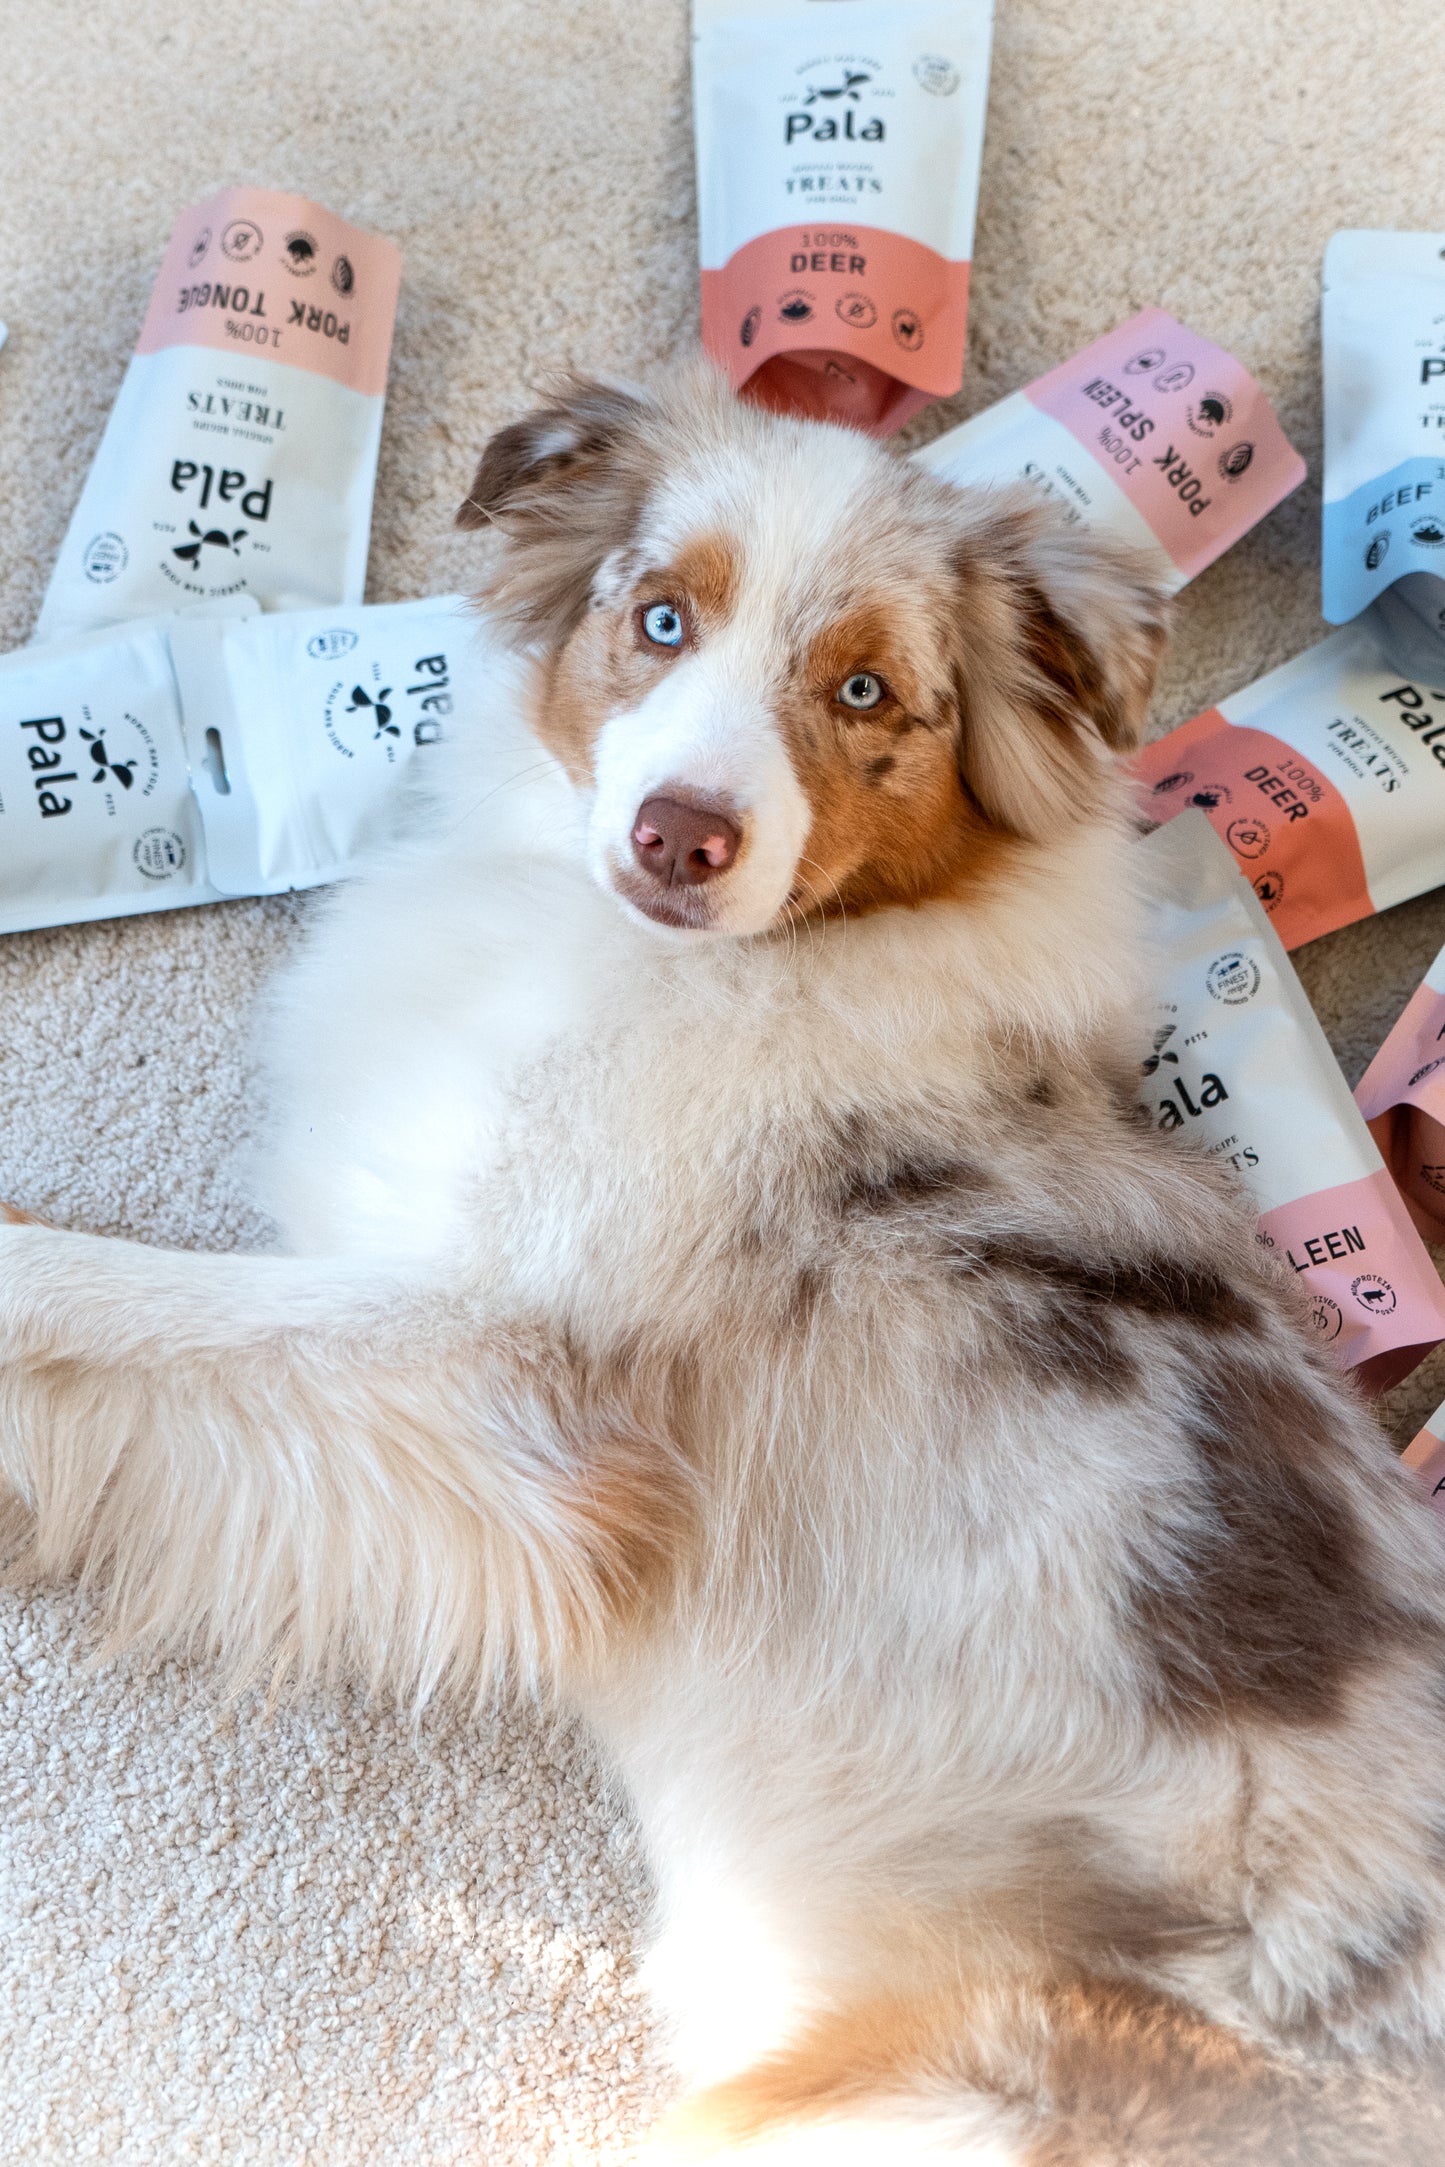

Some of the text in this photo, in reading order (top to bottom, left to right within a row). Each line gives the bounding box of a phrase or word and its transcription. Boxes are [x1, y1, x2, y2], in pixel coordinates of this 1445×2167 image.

[786, 111, 884, 144] Pala
[786, 176, 882, 194] TREATS
[802, 233, 858, 249] 100%
[790, 252, 867, 276] DEER
[177, 283, 350, 345] PORK TONGUE
[225, 319, 282, 348] 100%
[186, 391, 287, 431] TREATS
[1082, 379, 1155, 441] SPLEEN
[1097, 426, 1143, 476] 100%
[170, 459, 274, 522] Pala
[1153, 445, 1211, 518] PORK
[1366, 481, 1434, 525] BEEF
[184, 582, 204, 596] RAW
[325, 681, 355, 759] NORDIC RAW FOOD
[406, 654, 453, 747] Pala
[19, 716, 79, 819] Pala
[124, 712, 159, 797] NORDIC RAW FOOD
[1327, 719, 1401, 793] TREATS
[1244, 766, 1309, 823] DEER
[1277, 759, 1325, 803] 100%
[105, 792, 116, 816] PETS
[1217, 969, 1249, 990] FINEST
[1185, 1031, 1208, 1047] PETS
[1158, 1072, 1229, 1134] ala
[1208, 1134, 1239, 1156] ECIPE
[1287, 1225, 1366, 1273] LEEN
[1311, 1295, 1338, 1310] TIVES
[1351, 1274, 1392, 1297] MONOPROTEIN
[1375, 1306, 1395, 1316] PORK
